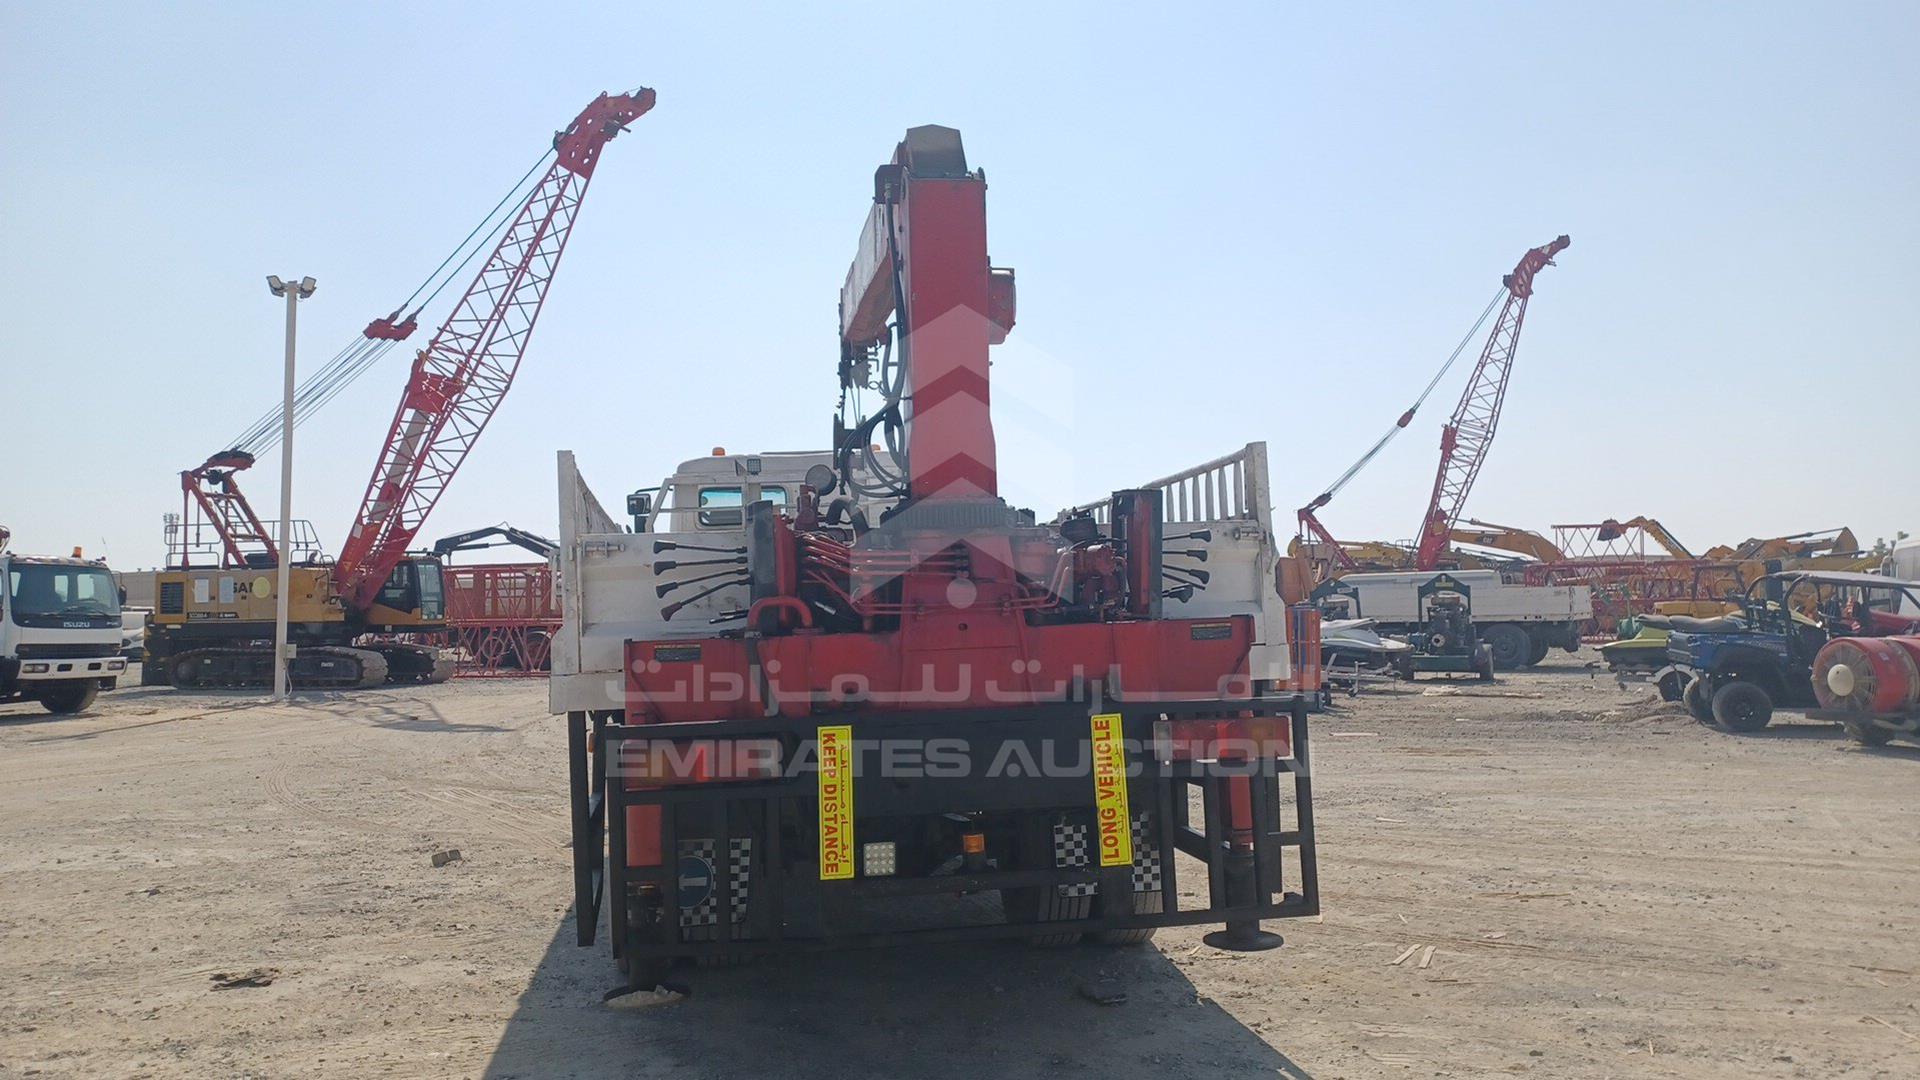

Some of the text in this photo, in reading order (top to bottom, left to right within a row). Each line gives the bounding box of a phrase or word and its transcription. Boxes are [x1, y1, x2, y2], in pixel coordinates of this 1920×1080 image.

[822, 733, 839, 874] KEEP DISTANCE
[1094, 720, 1120, 860] LONG VEHICLE
